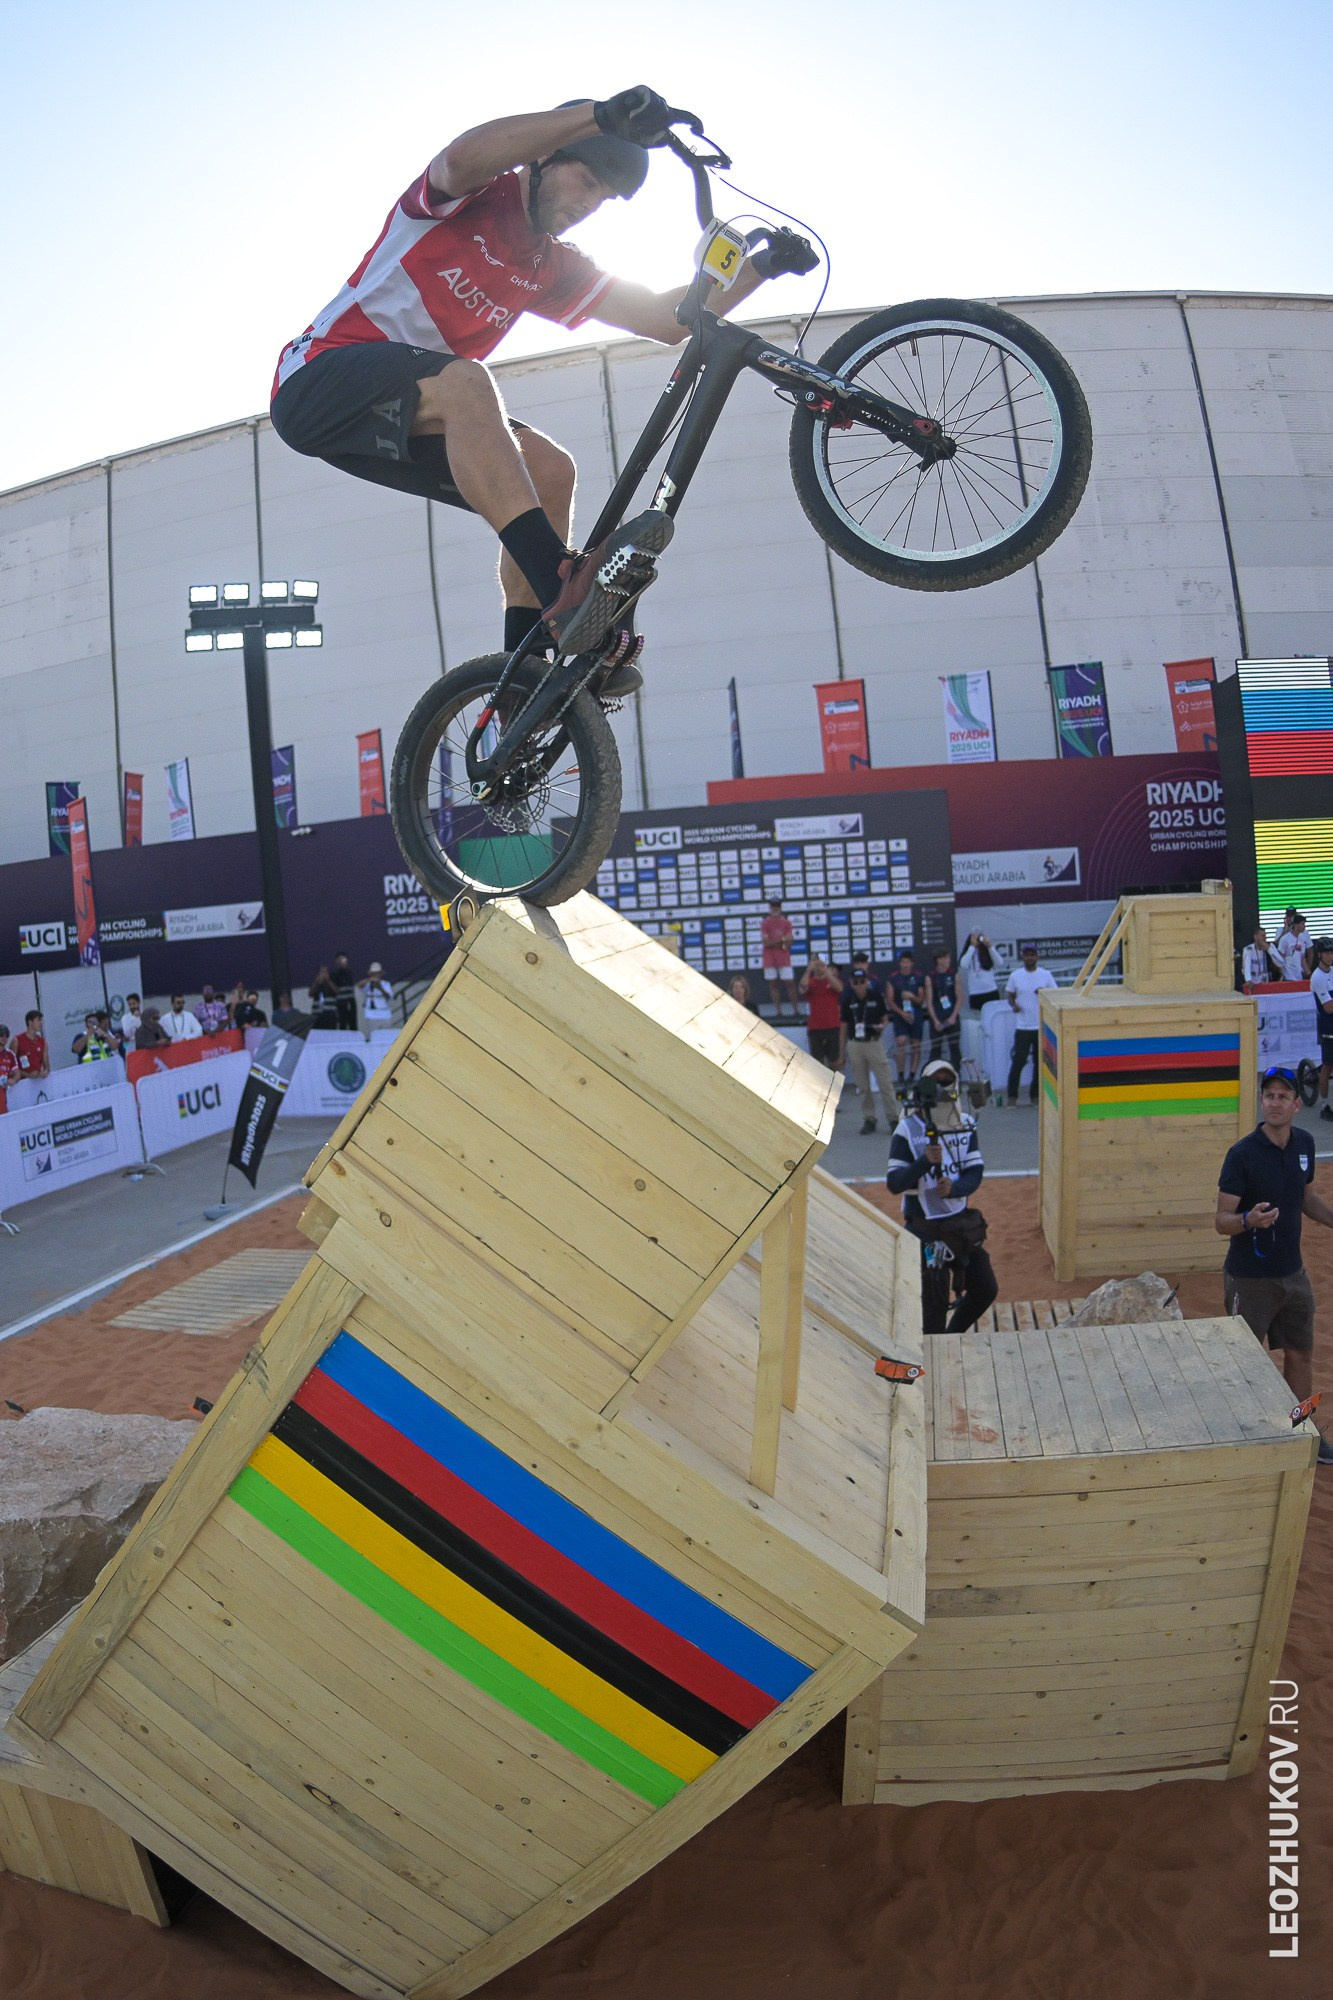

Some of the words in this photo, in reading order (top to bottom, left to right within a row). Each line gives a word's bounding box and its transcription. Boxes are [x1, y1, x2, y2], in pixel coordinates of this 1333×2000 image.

[721, 249, 737, 271] 5
[437, 267, 515, 330] AUSTRI
[1058, 695, 1102, 710] RIYADH
[949, 729, 990, 743] RIYADH
[950, 743, 972, 753] 2025
[973, 741, 991, 751] UCI
[1146, 780, 1224, 806] RIYADH
[1148, 808, 1195, 829] 2025
[1198, 807, 1226, 826] UC
[684, 836, 711, 846] WORLD
[710, 830, 772, 843] CHAMPIONSHIPS
[700, 827, 725, 836] URBAN
[725, 823, 758, 834] CYCLING
[1149, 831, 1175, 840] URBAN
[1175, 830, 1208, 839] CYCLING
[643, 830, 677, 847] UCI
[1150, 839, 1228, 853] CHAMPIONSHIP
[384, 873, 422, 896] RIY
[952, 873, 985, 885] SAUDI
[987, 871, 1026, 882] ARABIA
[385, 897, 429, 915] 2025
[68, 925, 77, 935] 20
[112, 918, 147, 930] CYCLING
[27, 930, 62, 948] UCI
[995, 943, 1014, 958] CI
[272, 1038, 289, 1069] 1
[260, 1068, 281, 1085] UCI
[185, 1083, 222, 1116] UCI
[240, 1093, 268, 1167] #Riyadh2025
[25, 1128, 52, 1151] UCI
